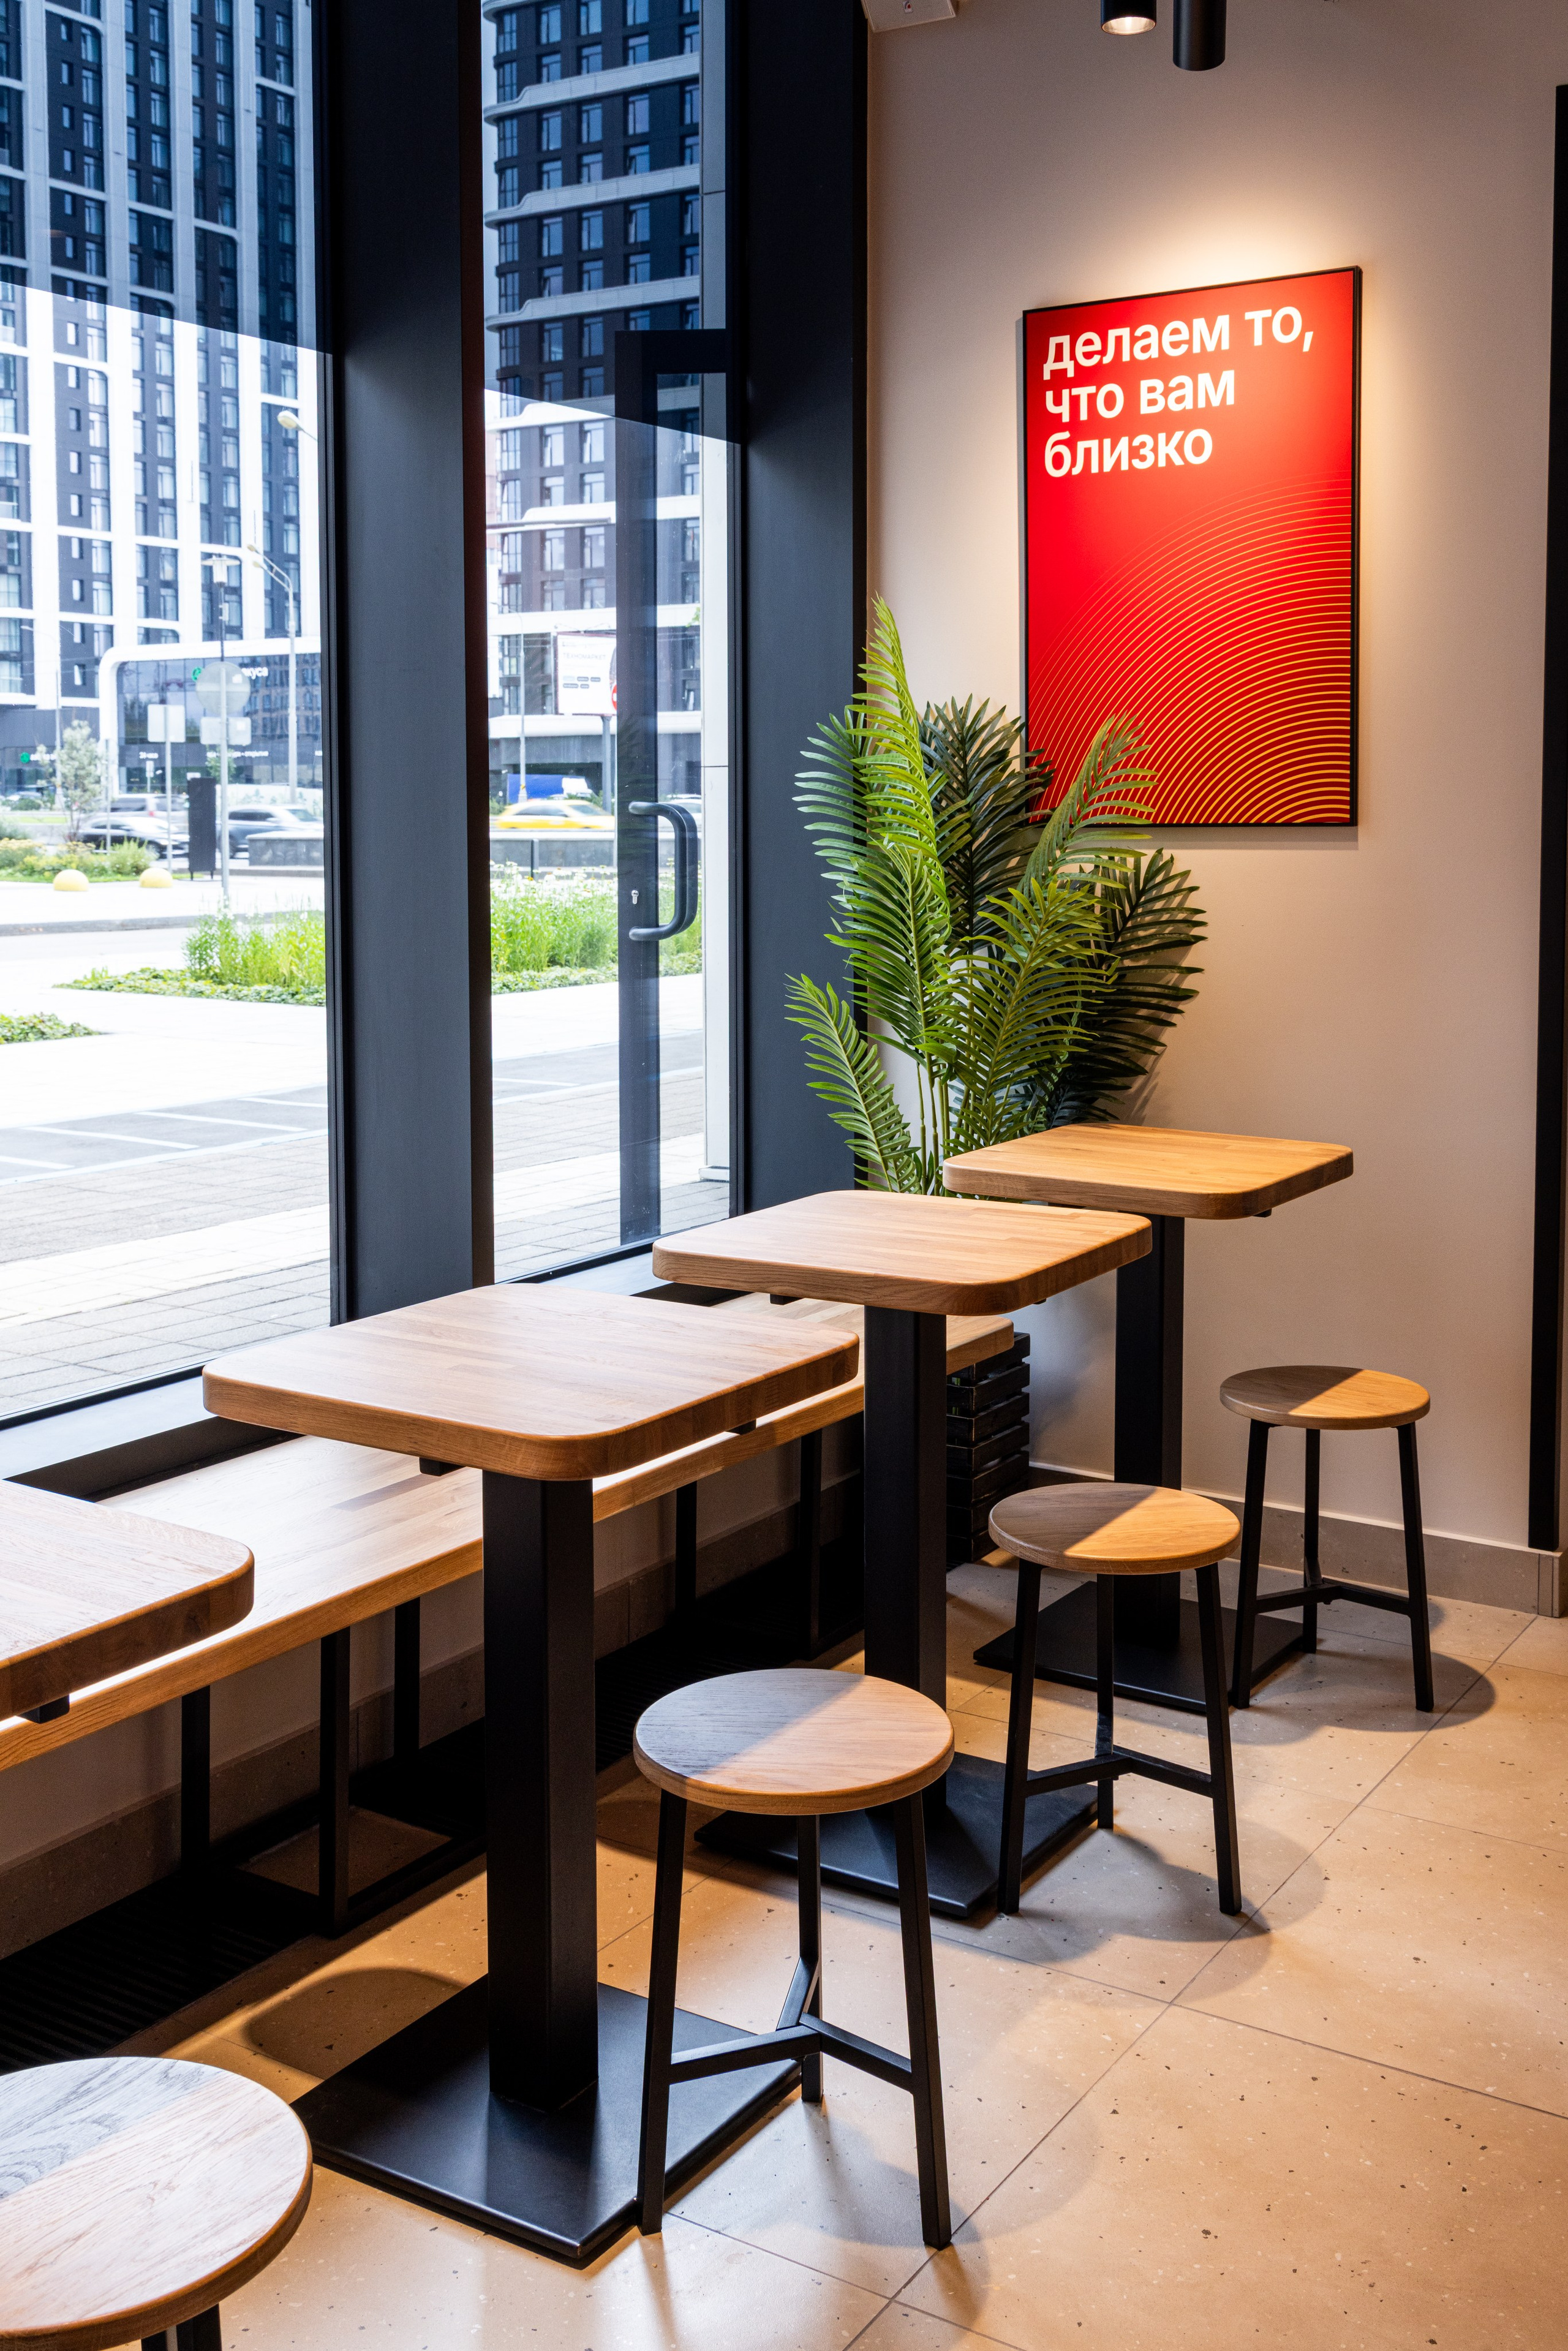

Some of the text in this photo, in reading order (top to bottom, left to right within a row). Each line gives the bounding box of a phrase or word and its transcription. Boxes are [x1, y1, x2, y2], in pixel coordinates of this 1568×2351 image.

[1043, 306, 1314, 380] делаем то,
[1046, 369, 1235, 423] что вам
[1044, 428, 1213, 477] близко
